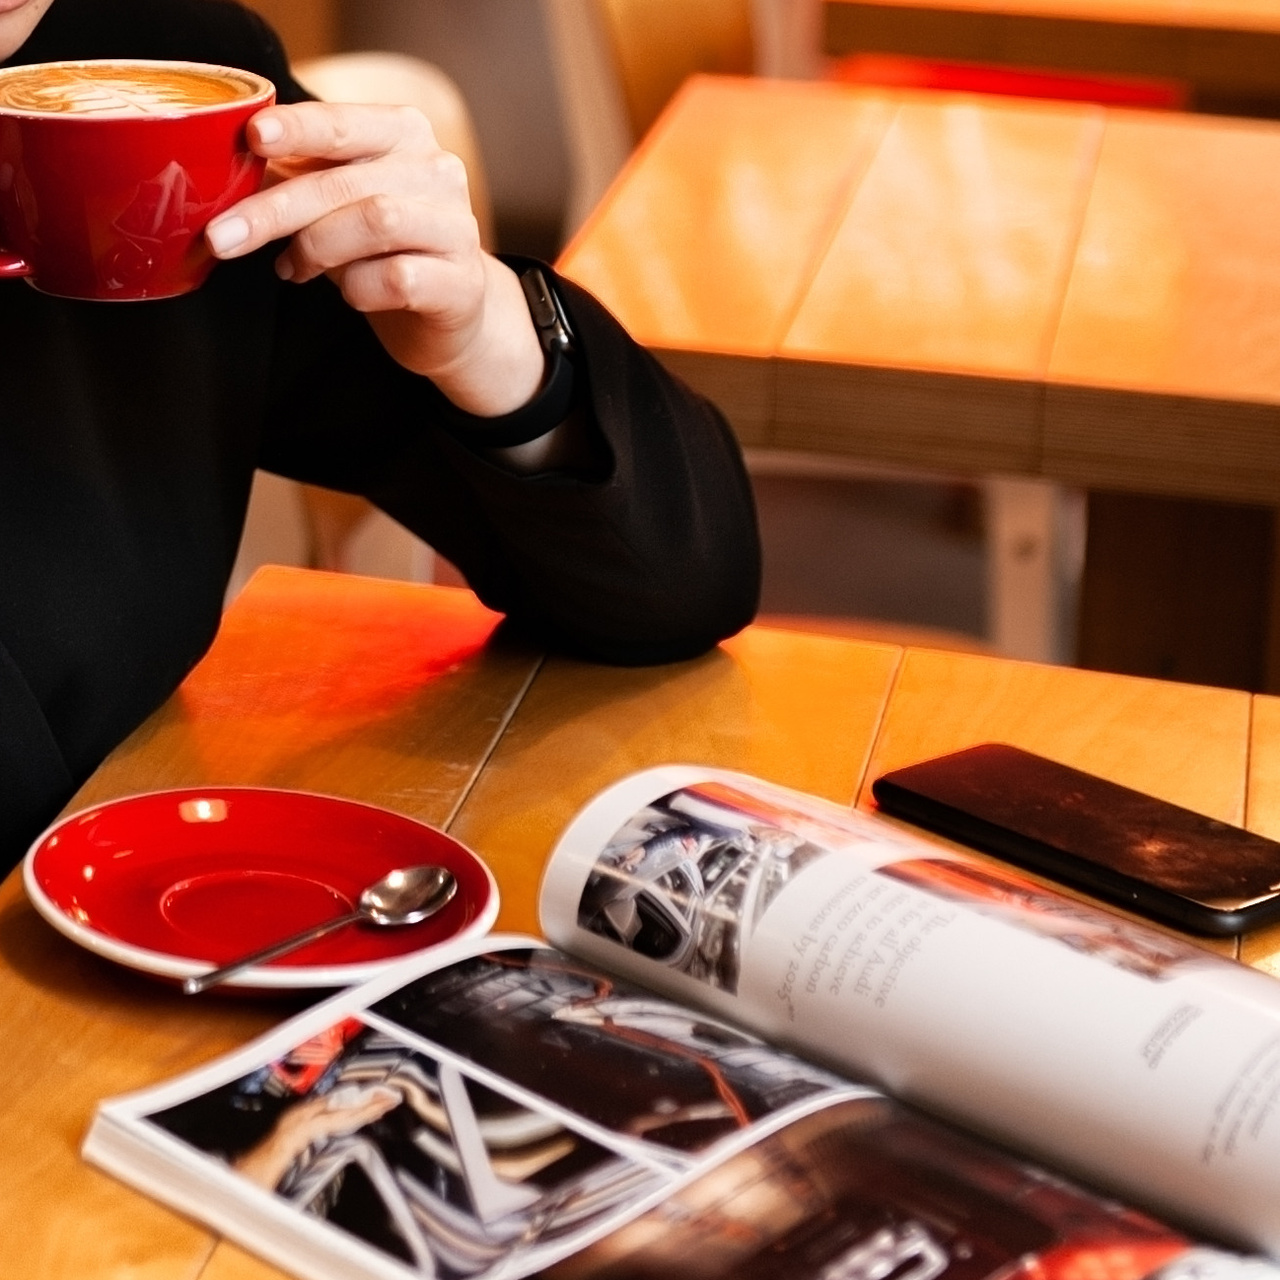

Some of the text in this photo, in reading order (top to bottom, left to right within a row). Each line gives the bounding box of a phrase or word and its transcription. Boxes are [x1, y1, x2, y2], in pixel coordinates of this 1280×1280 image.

[793, 934, 818, 958] by
[866, 914, 884, 931] to
[880, 928, 900, 950] all
[806, 933, 839, 994] carbon
[830, 932, 868, 996] achieve
[854, 950, 886, 997] Audi
[874, 936, 922, 1008] objective
